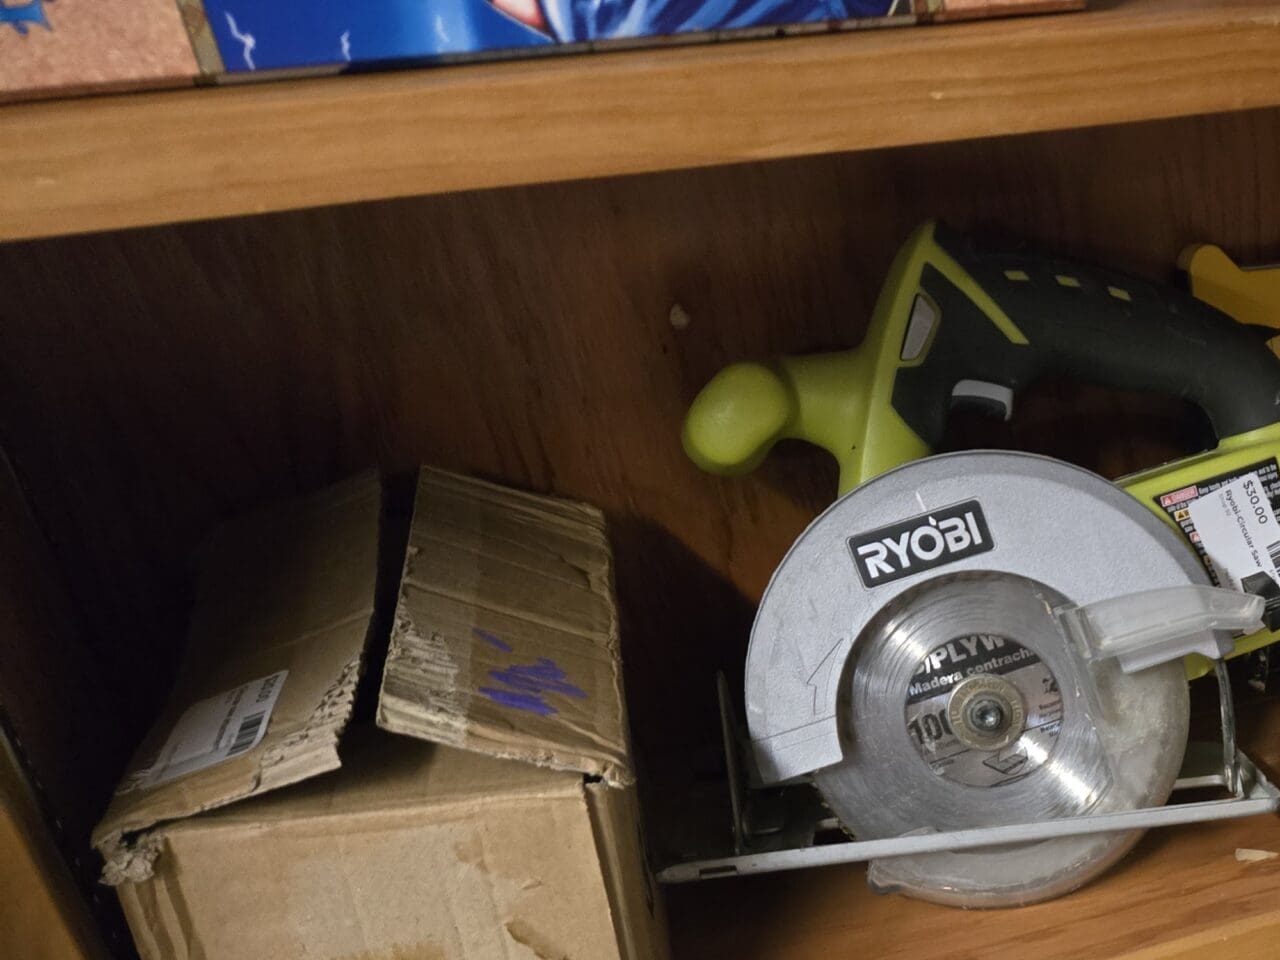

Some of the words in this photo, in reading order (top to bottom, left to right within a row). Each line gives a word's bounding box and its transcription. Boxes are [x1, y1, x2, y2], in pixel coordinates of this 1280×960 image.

[1223, 488, 1255, 549] Ryobi-Circular
[1250, 549, 1263, 568] Saw
[1241, 479, 1269, 525] $30.00
[856, 512, 984, 579] RYOBI
[909, 670, 964, 696] Madera
